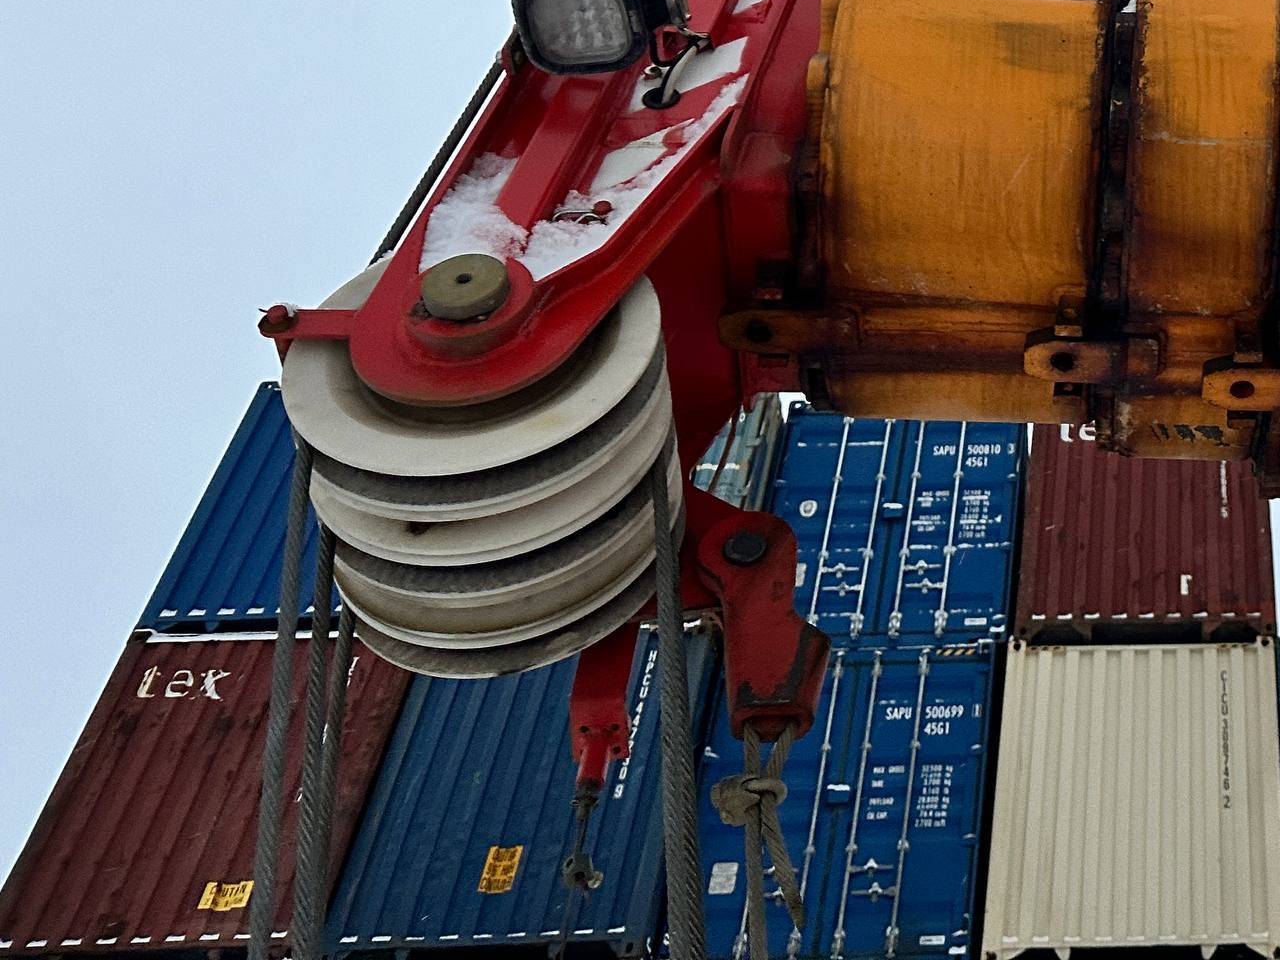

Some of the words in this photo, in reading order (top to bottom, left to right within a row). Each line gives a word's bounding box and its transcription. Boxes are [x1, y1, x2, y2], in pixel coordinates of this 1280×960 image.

[933, 445, 956, 456] SAPU
[967, 443, 1001, 456] 500810
[965, 456, 988, 467] 45G1
[639, 650, 658, 699] HPCU
[136, 665, 232, 701] tex
[885, 707, 913, 721] SAPU
[925, 705, 964, 719] 500699
[923, 722, 950, 735] 45G1
[1223, 795, 1231, 809] 2
